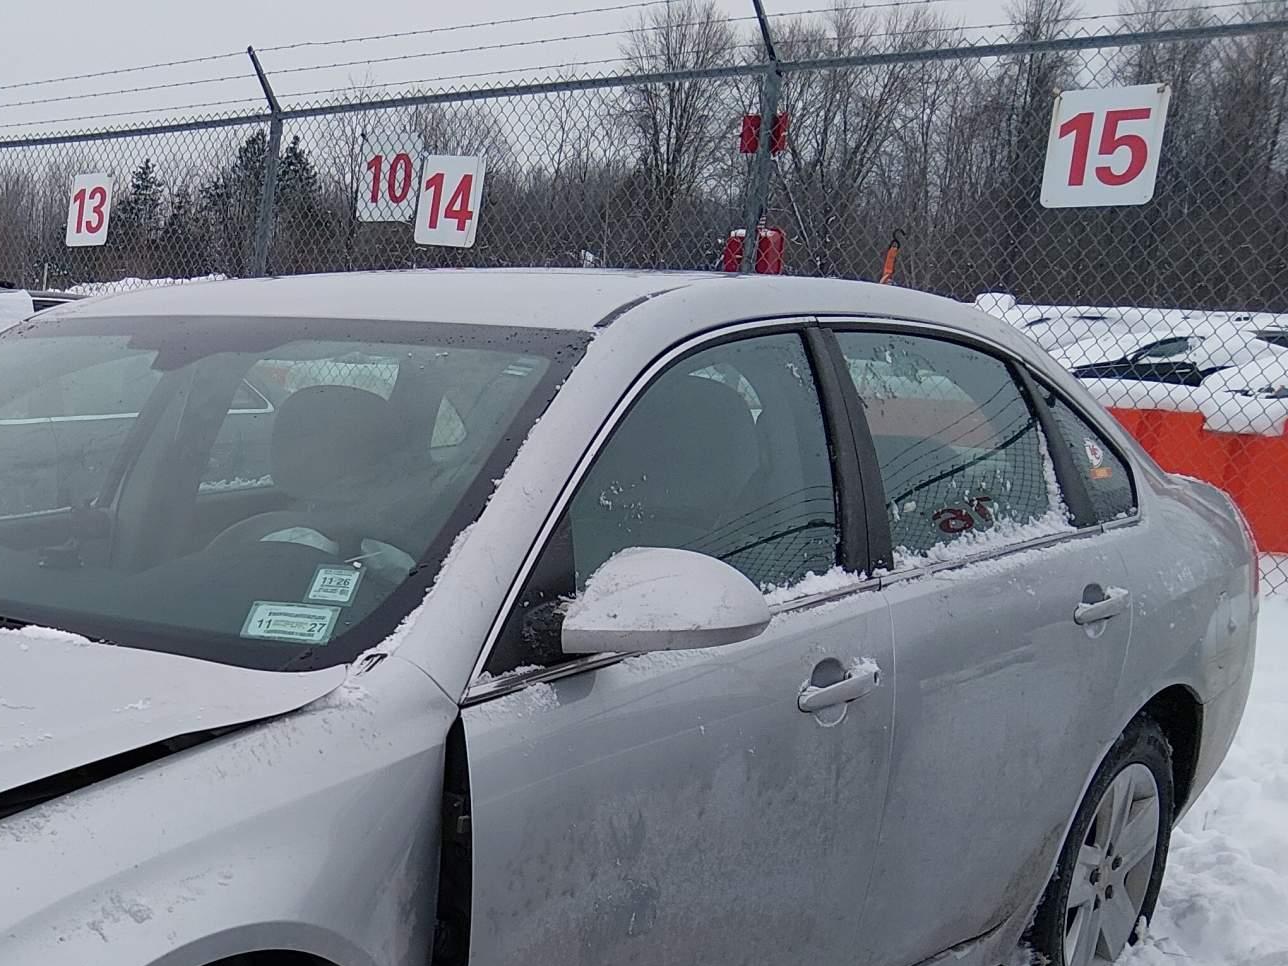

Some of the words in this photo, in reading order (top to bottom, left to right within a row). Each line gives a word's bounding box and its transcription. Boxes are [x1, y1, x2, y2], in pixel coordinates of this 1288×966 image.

[1057, 107, 1152, 187] 15
[366, 152, 412, 204] 10
[424, 172, 473, 231] 14
[72, 186, 107, 234] 13
[256, 618, 273, 629] 11
[306, 622, 327, 633] 27
